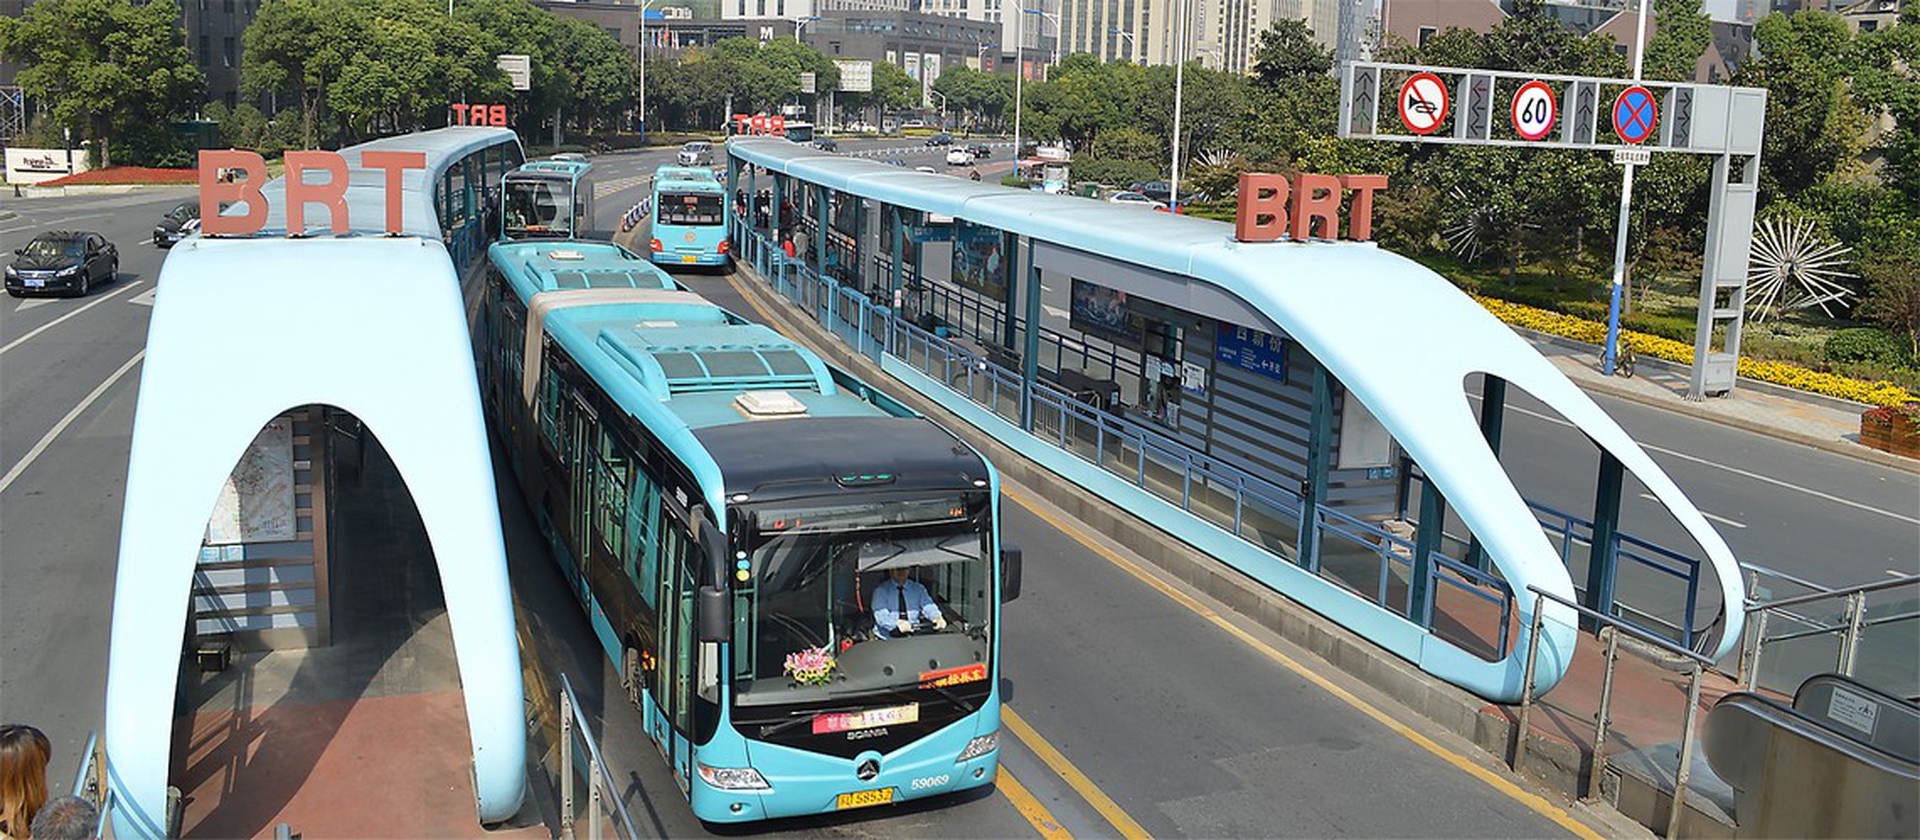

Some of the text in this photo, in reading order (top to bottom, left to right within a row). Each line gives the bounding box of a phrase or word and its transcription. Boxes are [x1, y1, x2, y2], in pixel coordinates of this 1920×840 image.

[1522, 97, 1547, 124] 60
[198, 149, 427, 236] BRT
[1236, 172, 1389, 243] BRT
[846, 728, 889, 740] SCANIA
[911, 774, 949, 790] 59069
